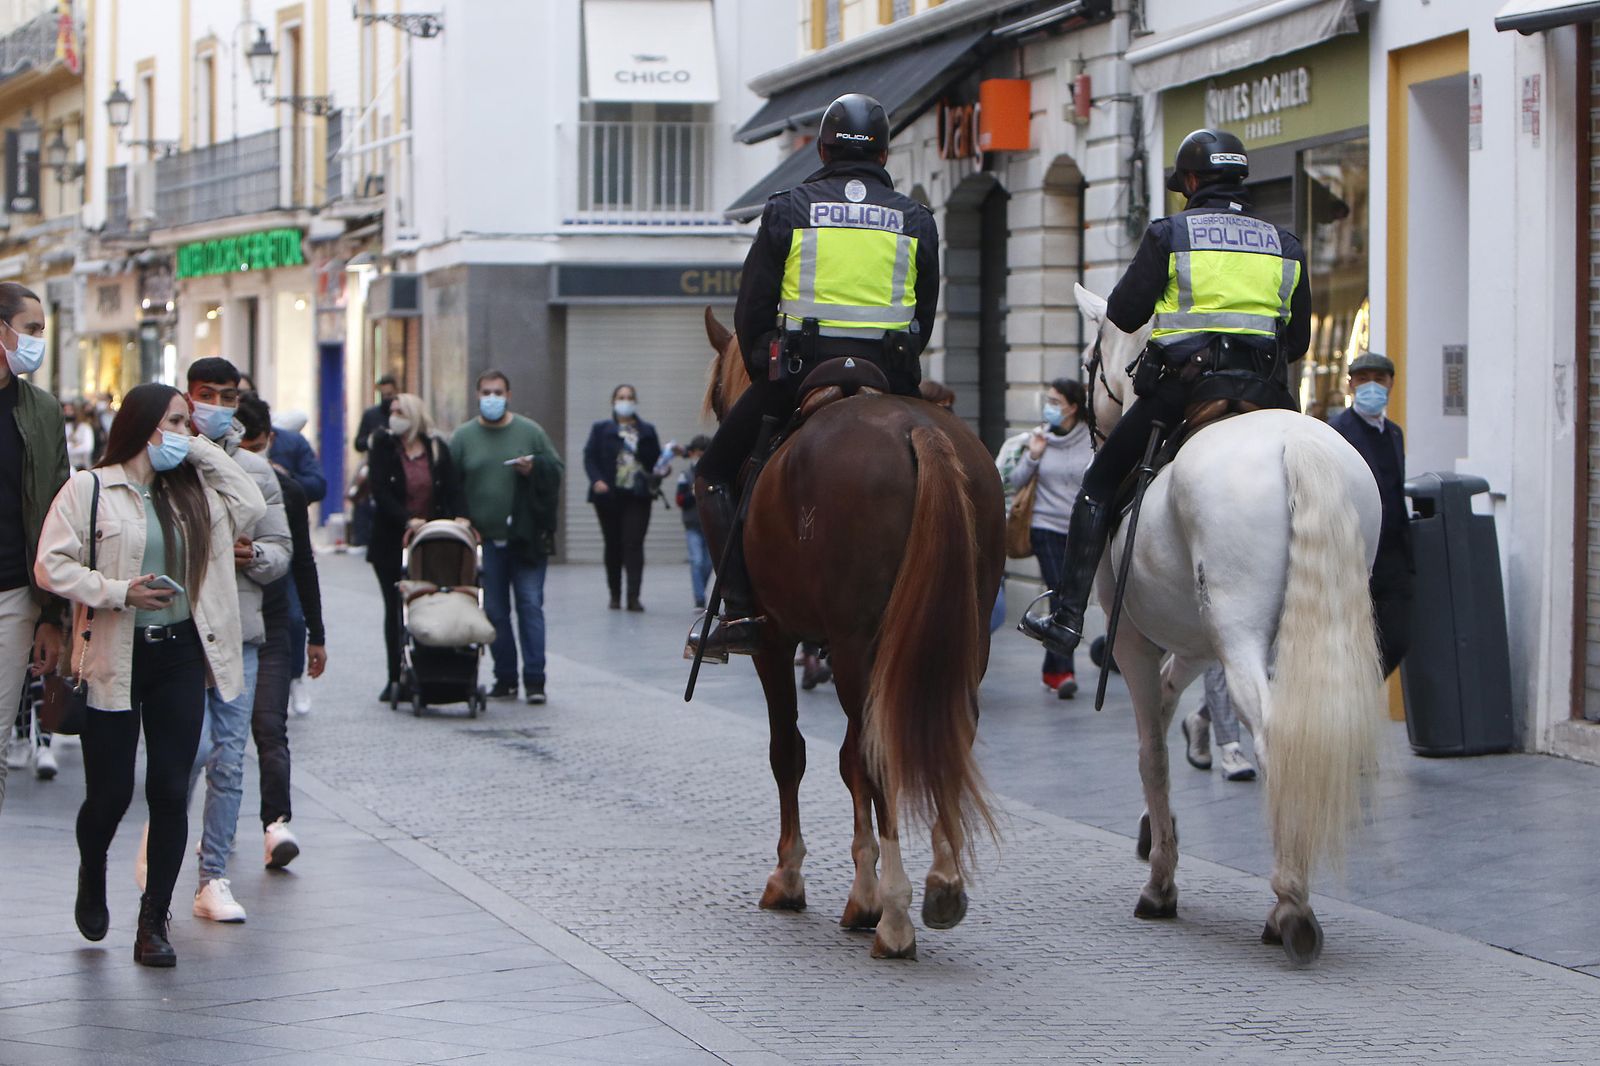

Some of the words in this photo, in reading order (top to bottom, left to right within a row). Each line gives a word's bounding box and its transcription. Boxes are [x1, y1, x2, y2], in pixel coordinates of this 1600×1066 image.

[613, 69, 691, 84] CHICO
[1252, 66, 1309, 117] ROCHER
[836, 132, 869, 141] POLICIA
[1244, 116, 1282, 140] FRANCE
[814, 205, 899, 229] POLICIA
[1191, 216, 1225, 225] CUERPO
[1193, 227, 1279, 249] POLICIA
[680, 269, 742, 294] CHI
